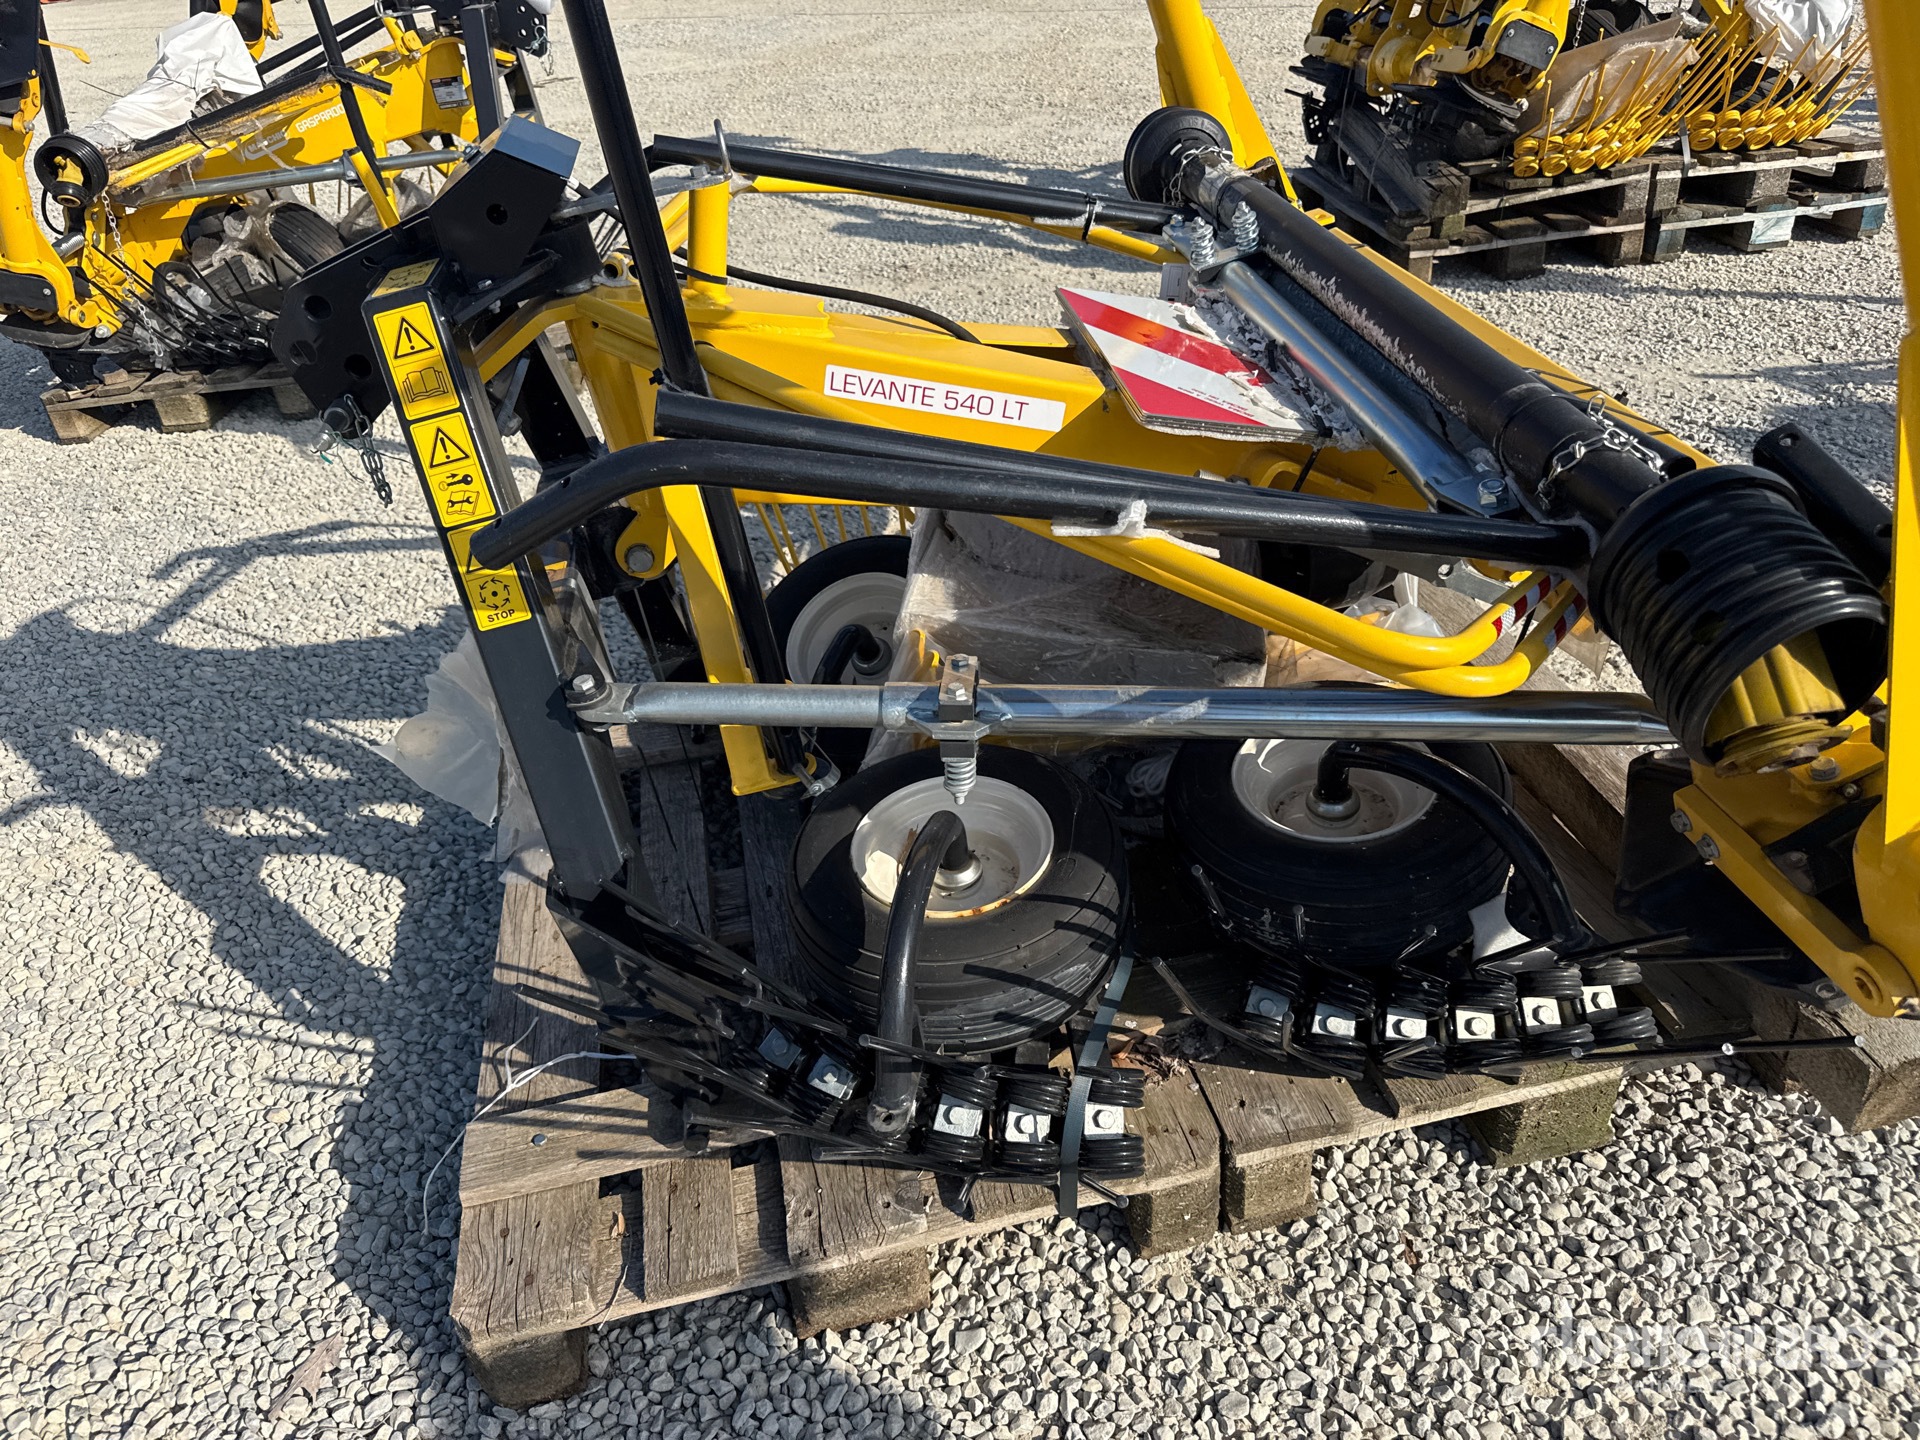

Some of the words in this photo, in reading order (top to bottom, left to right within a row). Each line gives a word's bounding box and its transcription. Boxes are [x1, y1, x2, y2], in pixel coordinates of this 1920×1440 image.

[295, 103, 346, 133] GASPARDO
[829, 371, 936, 407] LEVANTE
[943, 390, 994, 416] 540
[1002, 399, 1029, 421] LT
[487, 609, 515, 622] STOP
